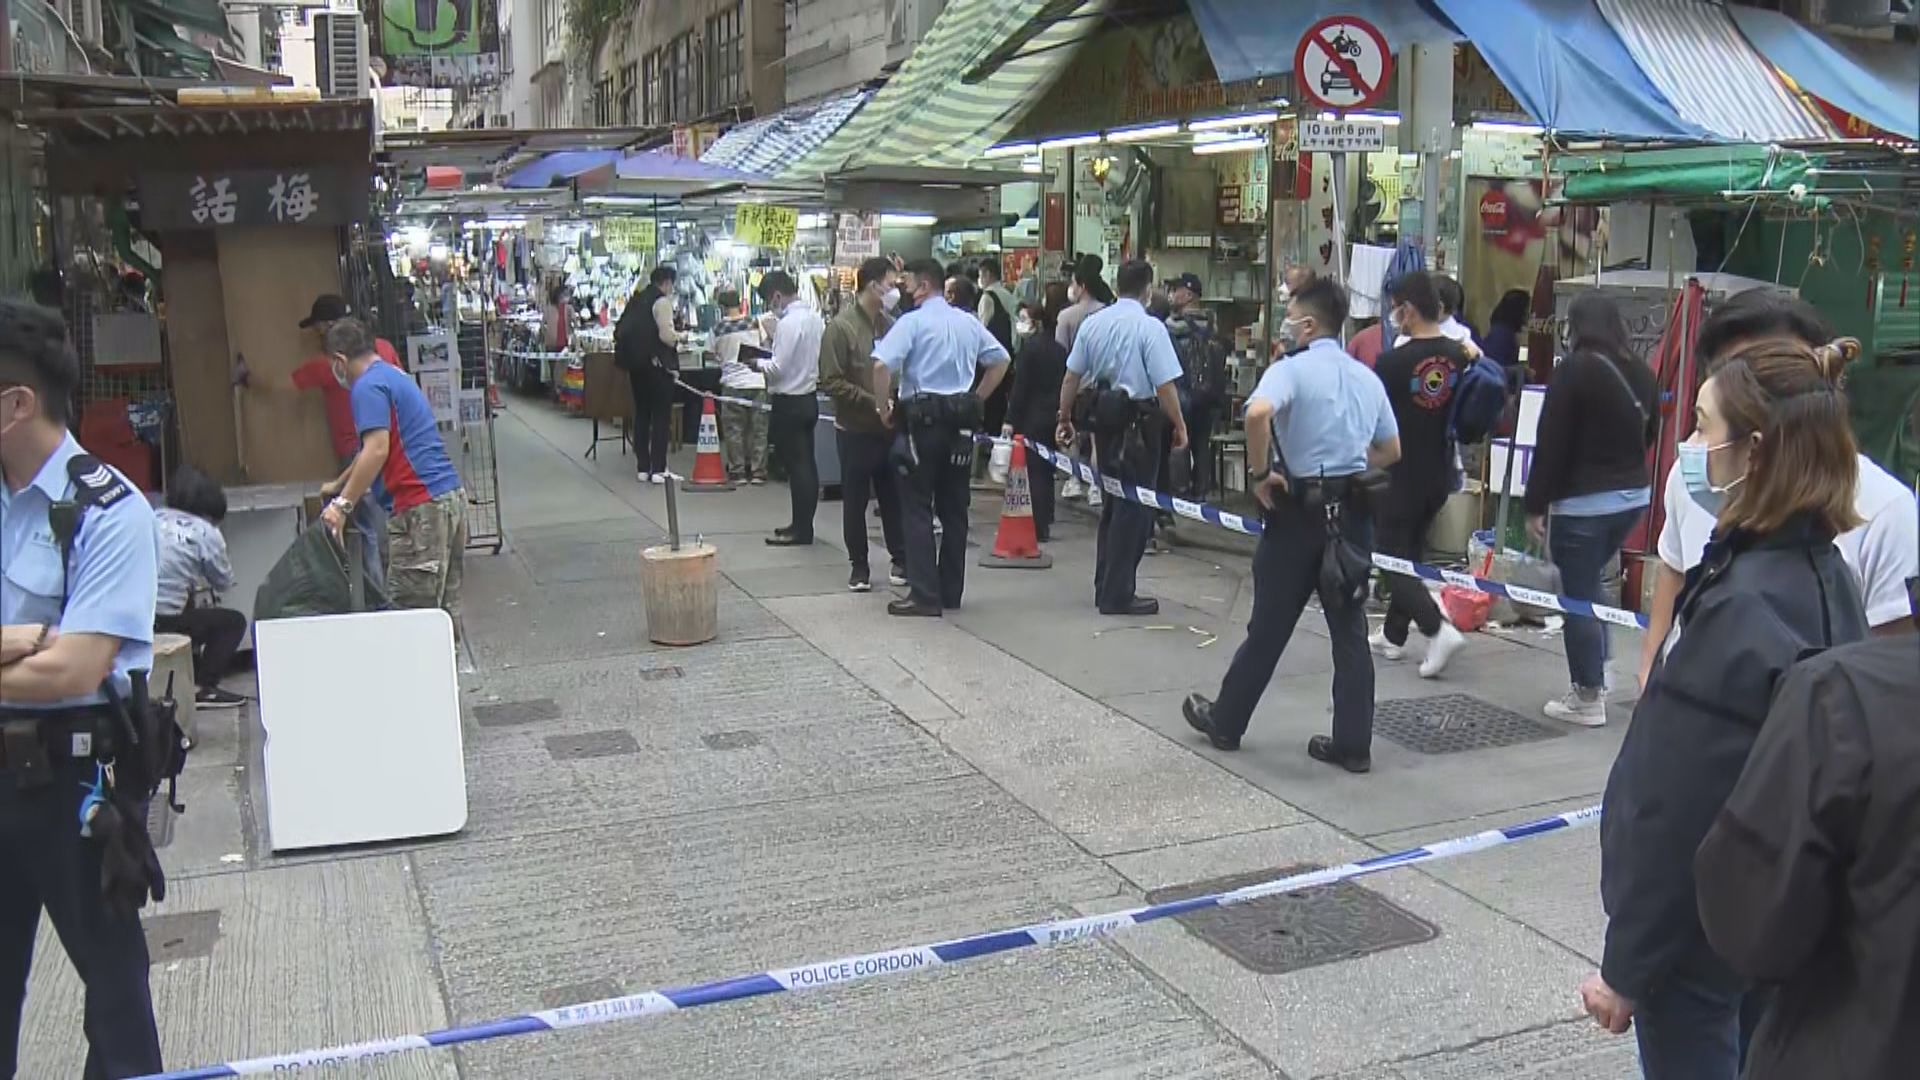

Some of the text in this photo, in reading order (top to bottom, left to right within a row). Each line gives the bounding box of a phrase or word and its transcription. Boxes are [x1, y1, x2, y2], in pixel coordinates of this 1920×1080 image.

[1307, 124, 1321, 135] 10
[1358, 127, 1376, 137] pm
[790, 951, 923, 986] POLICE CORDON
